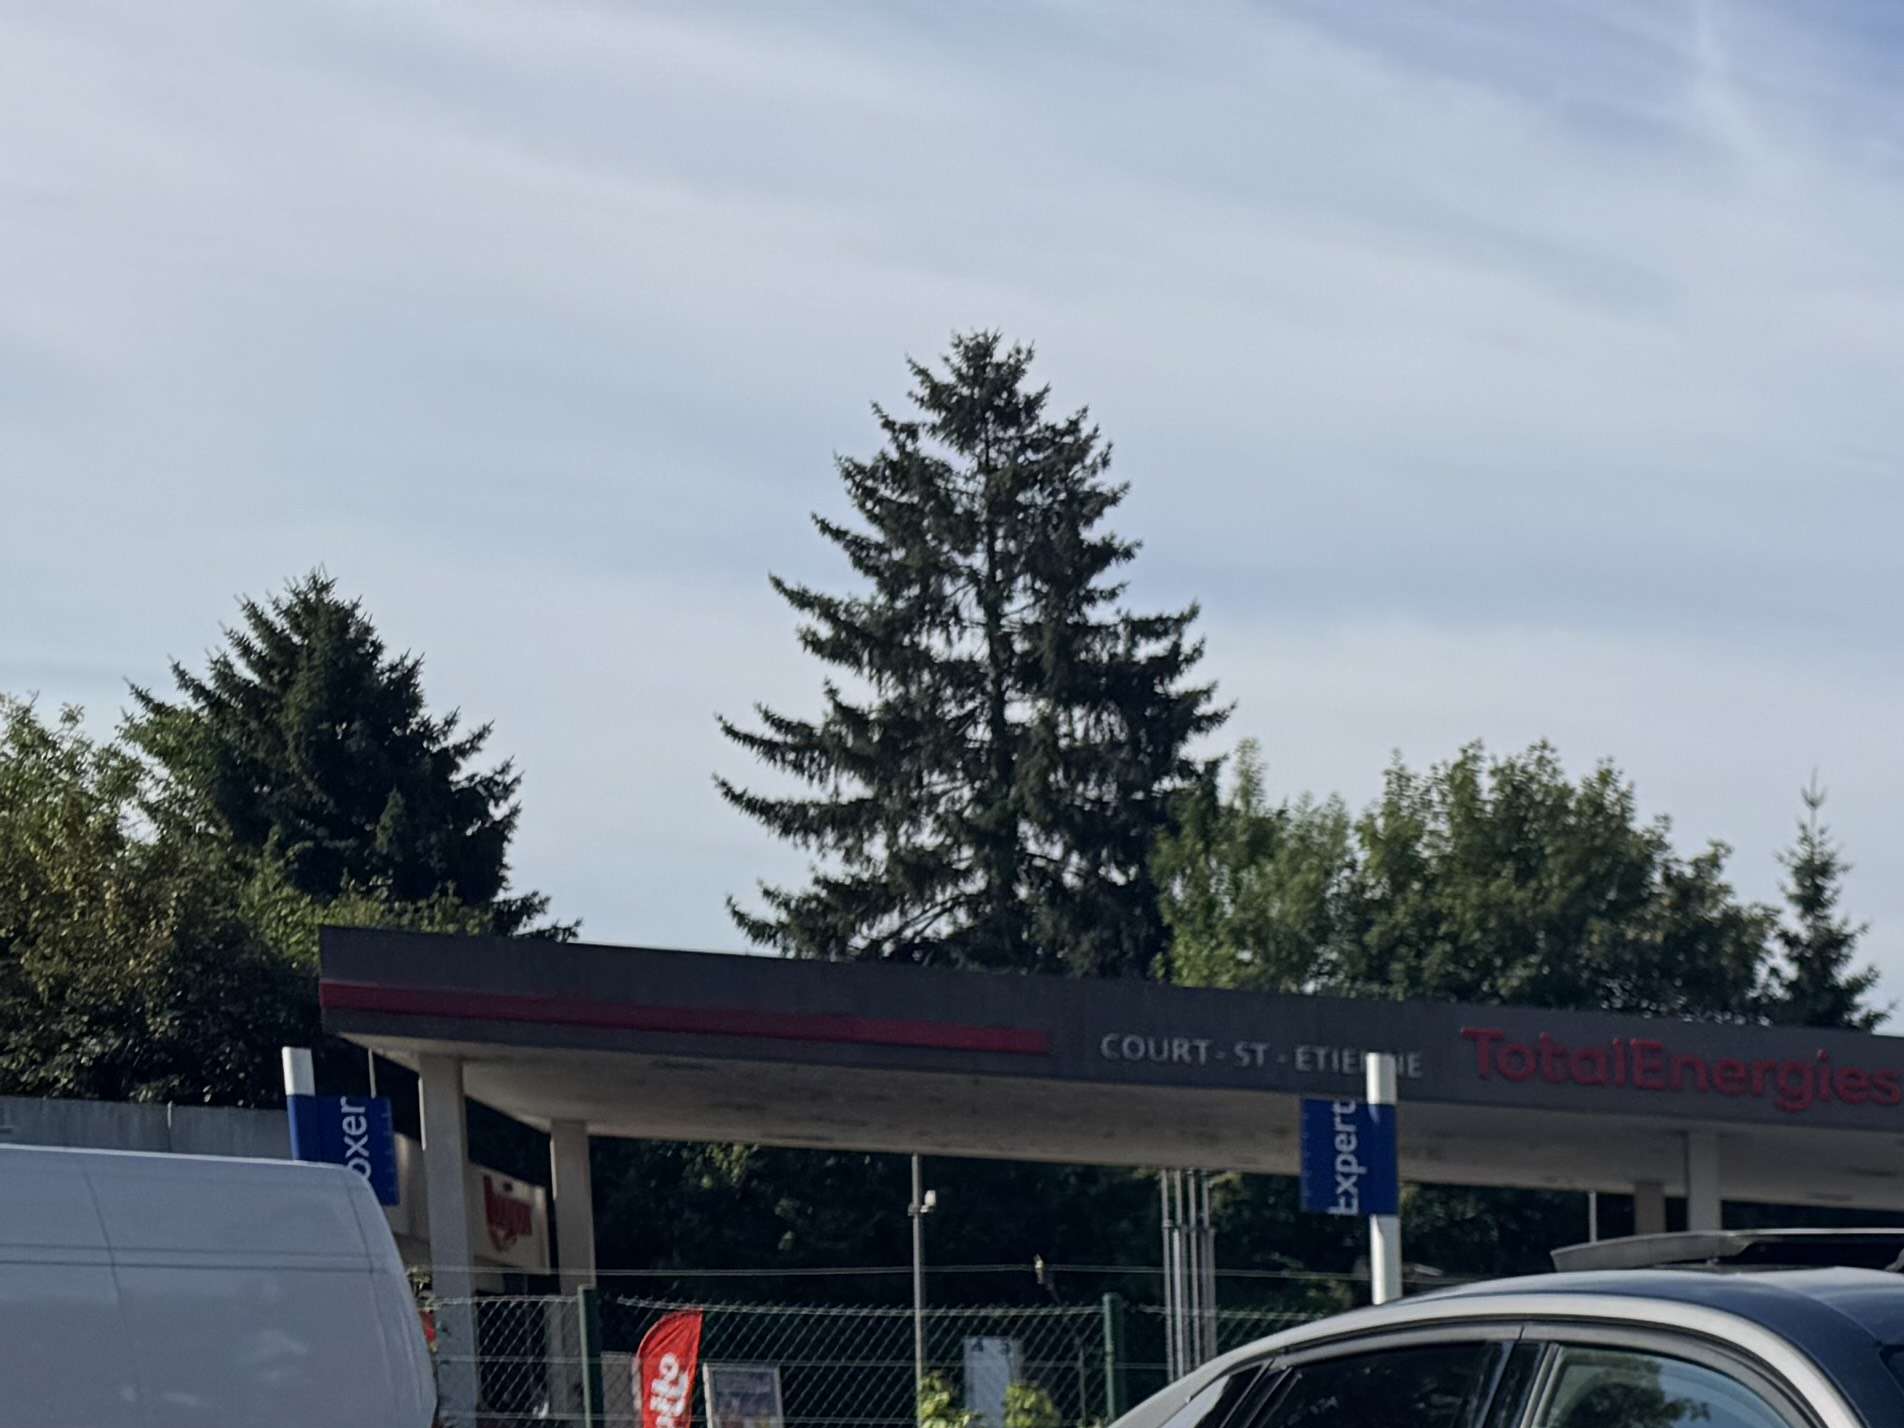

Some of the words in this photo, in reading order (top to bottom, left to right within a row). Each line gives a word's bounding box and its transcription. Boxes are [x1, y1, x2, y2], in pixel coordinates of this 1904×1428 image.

[1294, 1045, 1424, 1079] ETIEE
[1461, 1026, 1902, 1115] TotalEnergies
[340, 1096, 373, 1182] oxer
